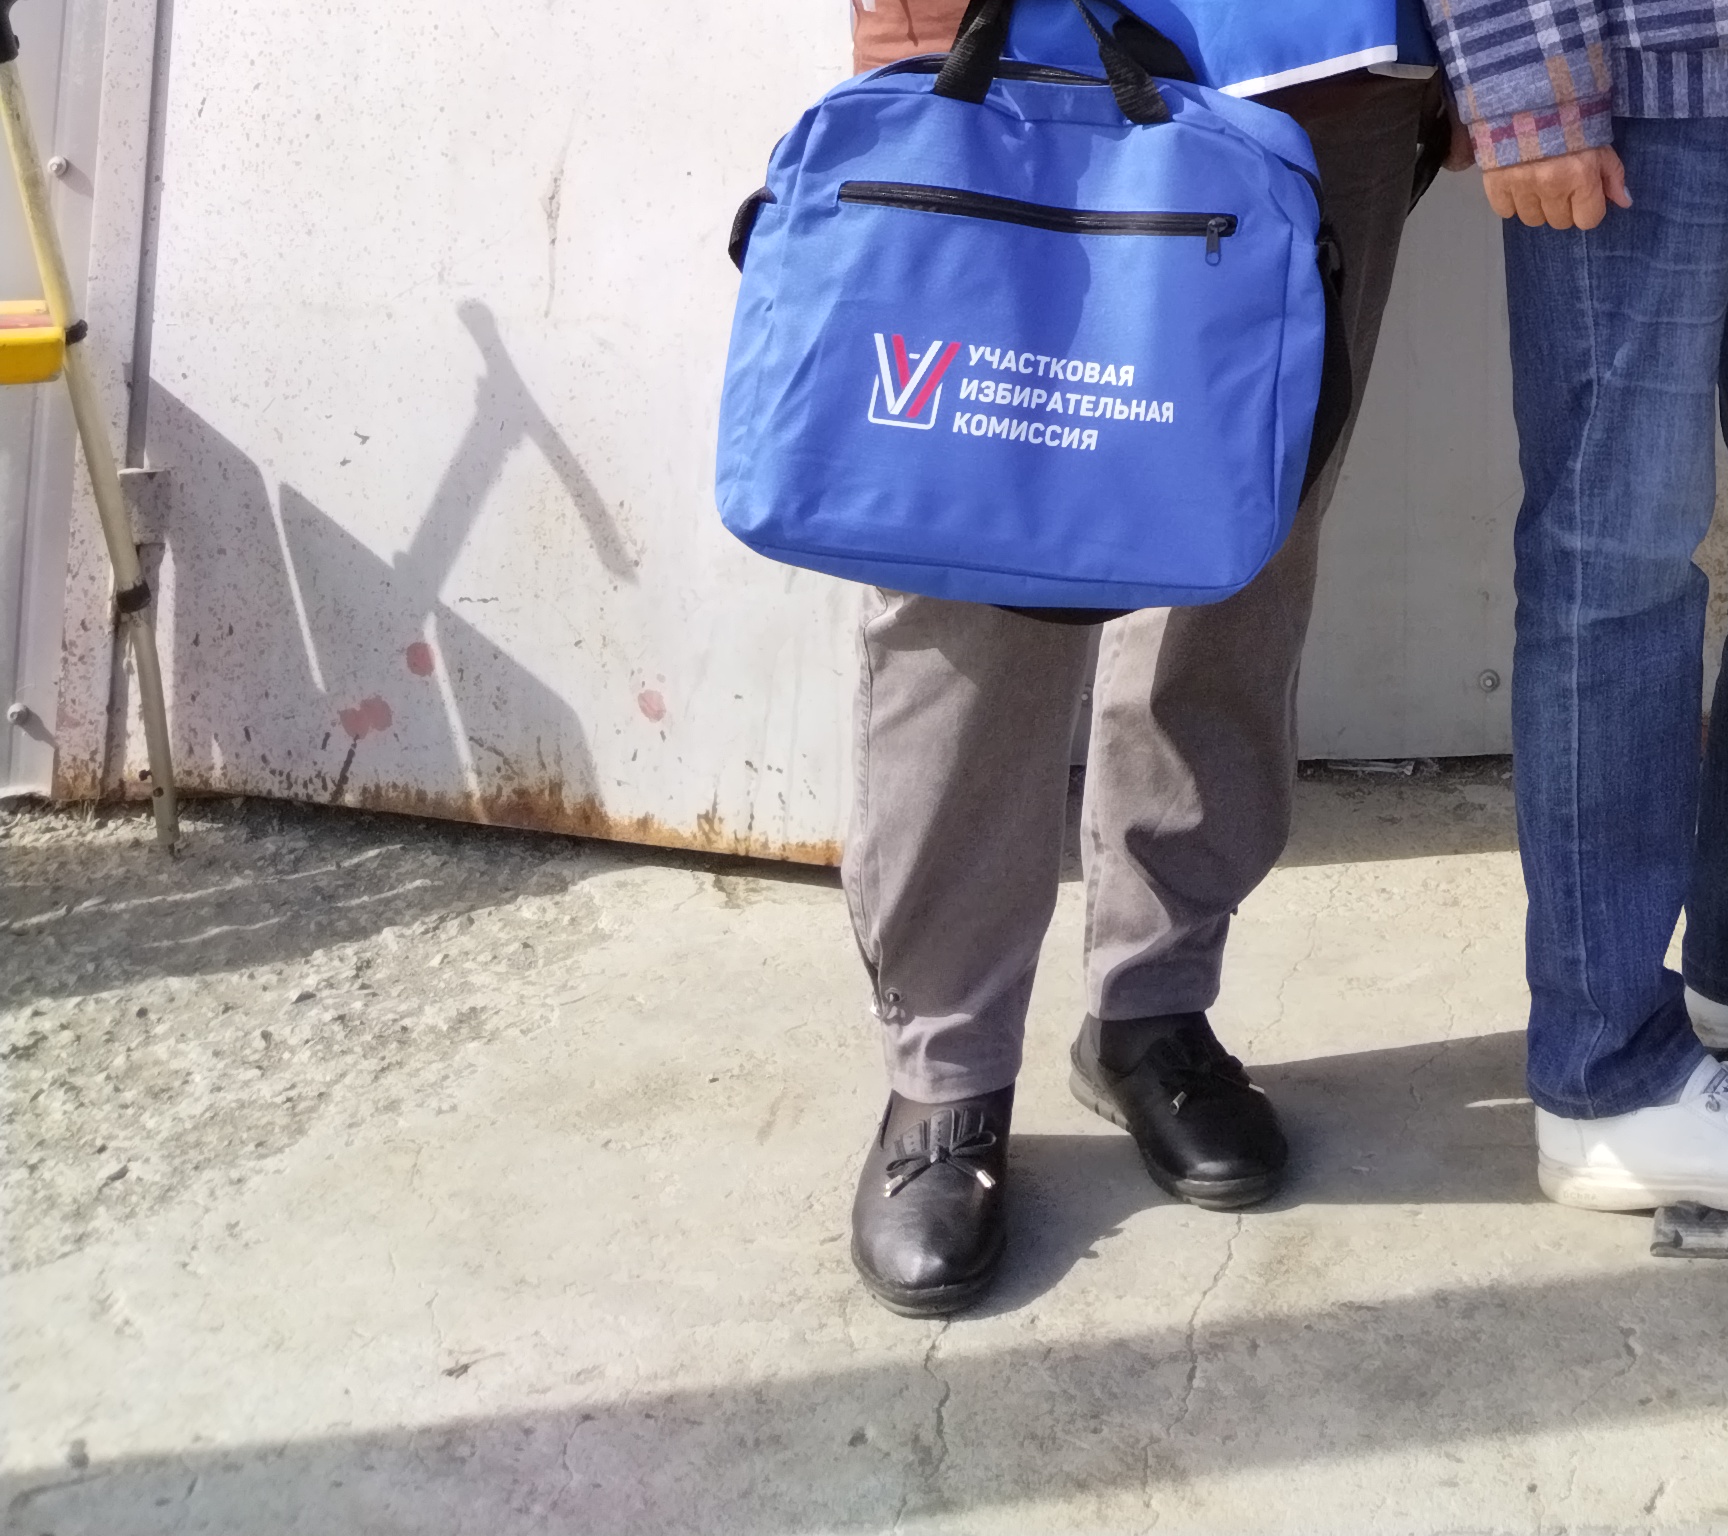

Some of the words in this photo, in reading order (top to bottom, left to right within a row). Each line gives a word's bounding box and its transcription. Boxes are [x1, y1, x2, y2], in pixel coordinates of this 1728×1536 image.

[968, 344, 1135, 387] УЧАСТКОВАЯ
[959, 378, 1175, 424] ИЗБИРАТЕЛЬНАЯ
[952, 412, 1099, 451] КОМИССИЯ
